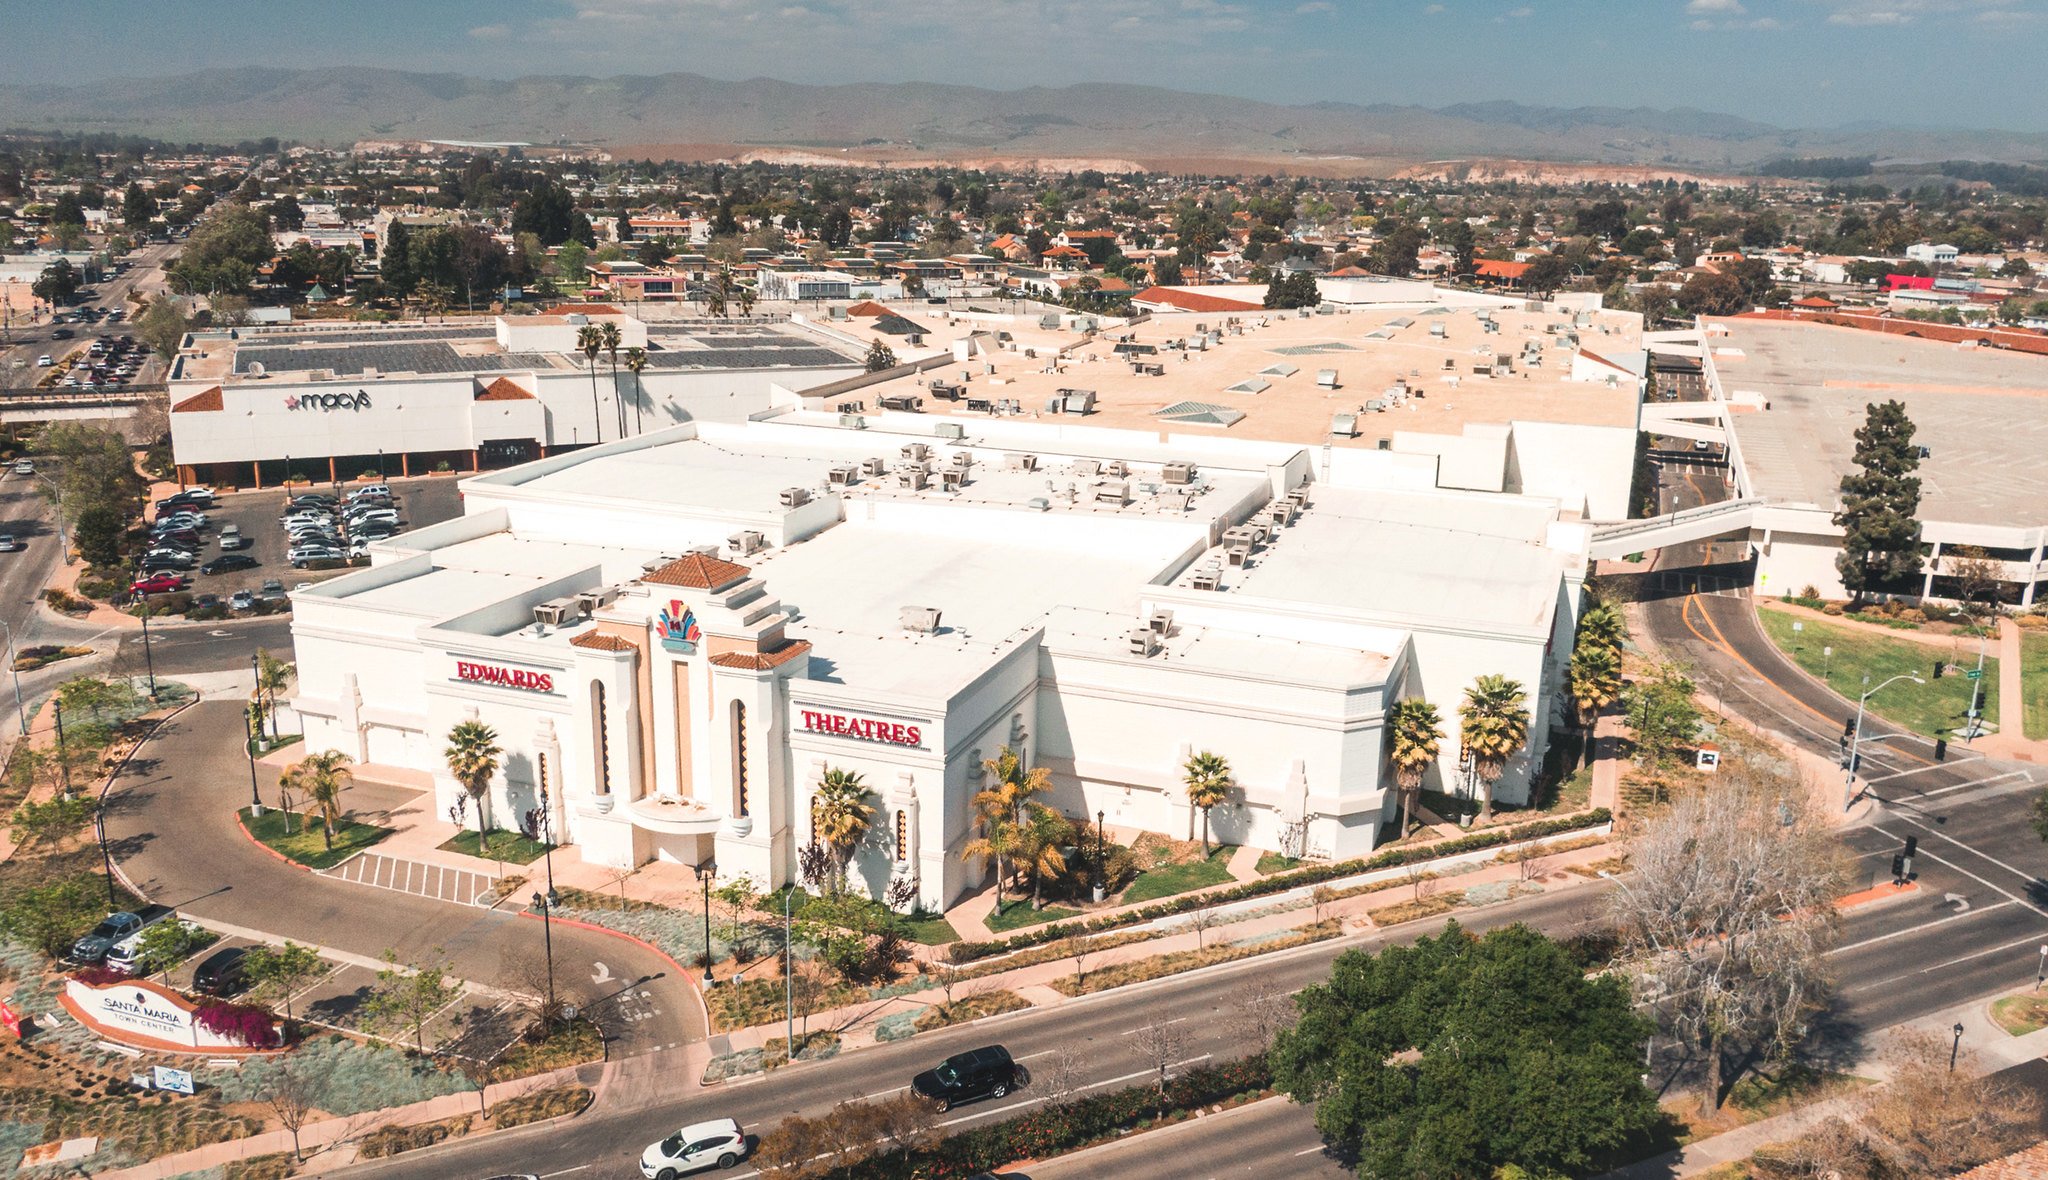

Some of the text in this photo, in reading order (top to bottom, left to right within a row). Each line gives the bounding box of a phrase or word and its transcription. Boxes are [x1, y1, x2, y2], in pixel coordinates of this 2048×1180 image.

[457, 661, 553, 691] EDWARDS
[801, 710, 921, 745] THEATRES
[104, 998, 181, 1024] SANTA MARIA
[114, 1014, 174, 1033] TOWN CENTER
